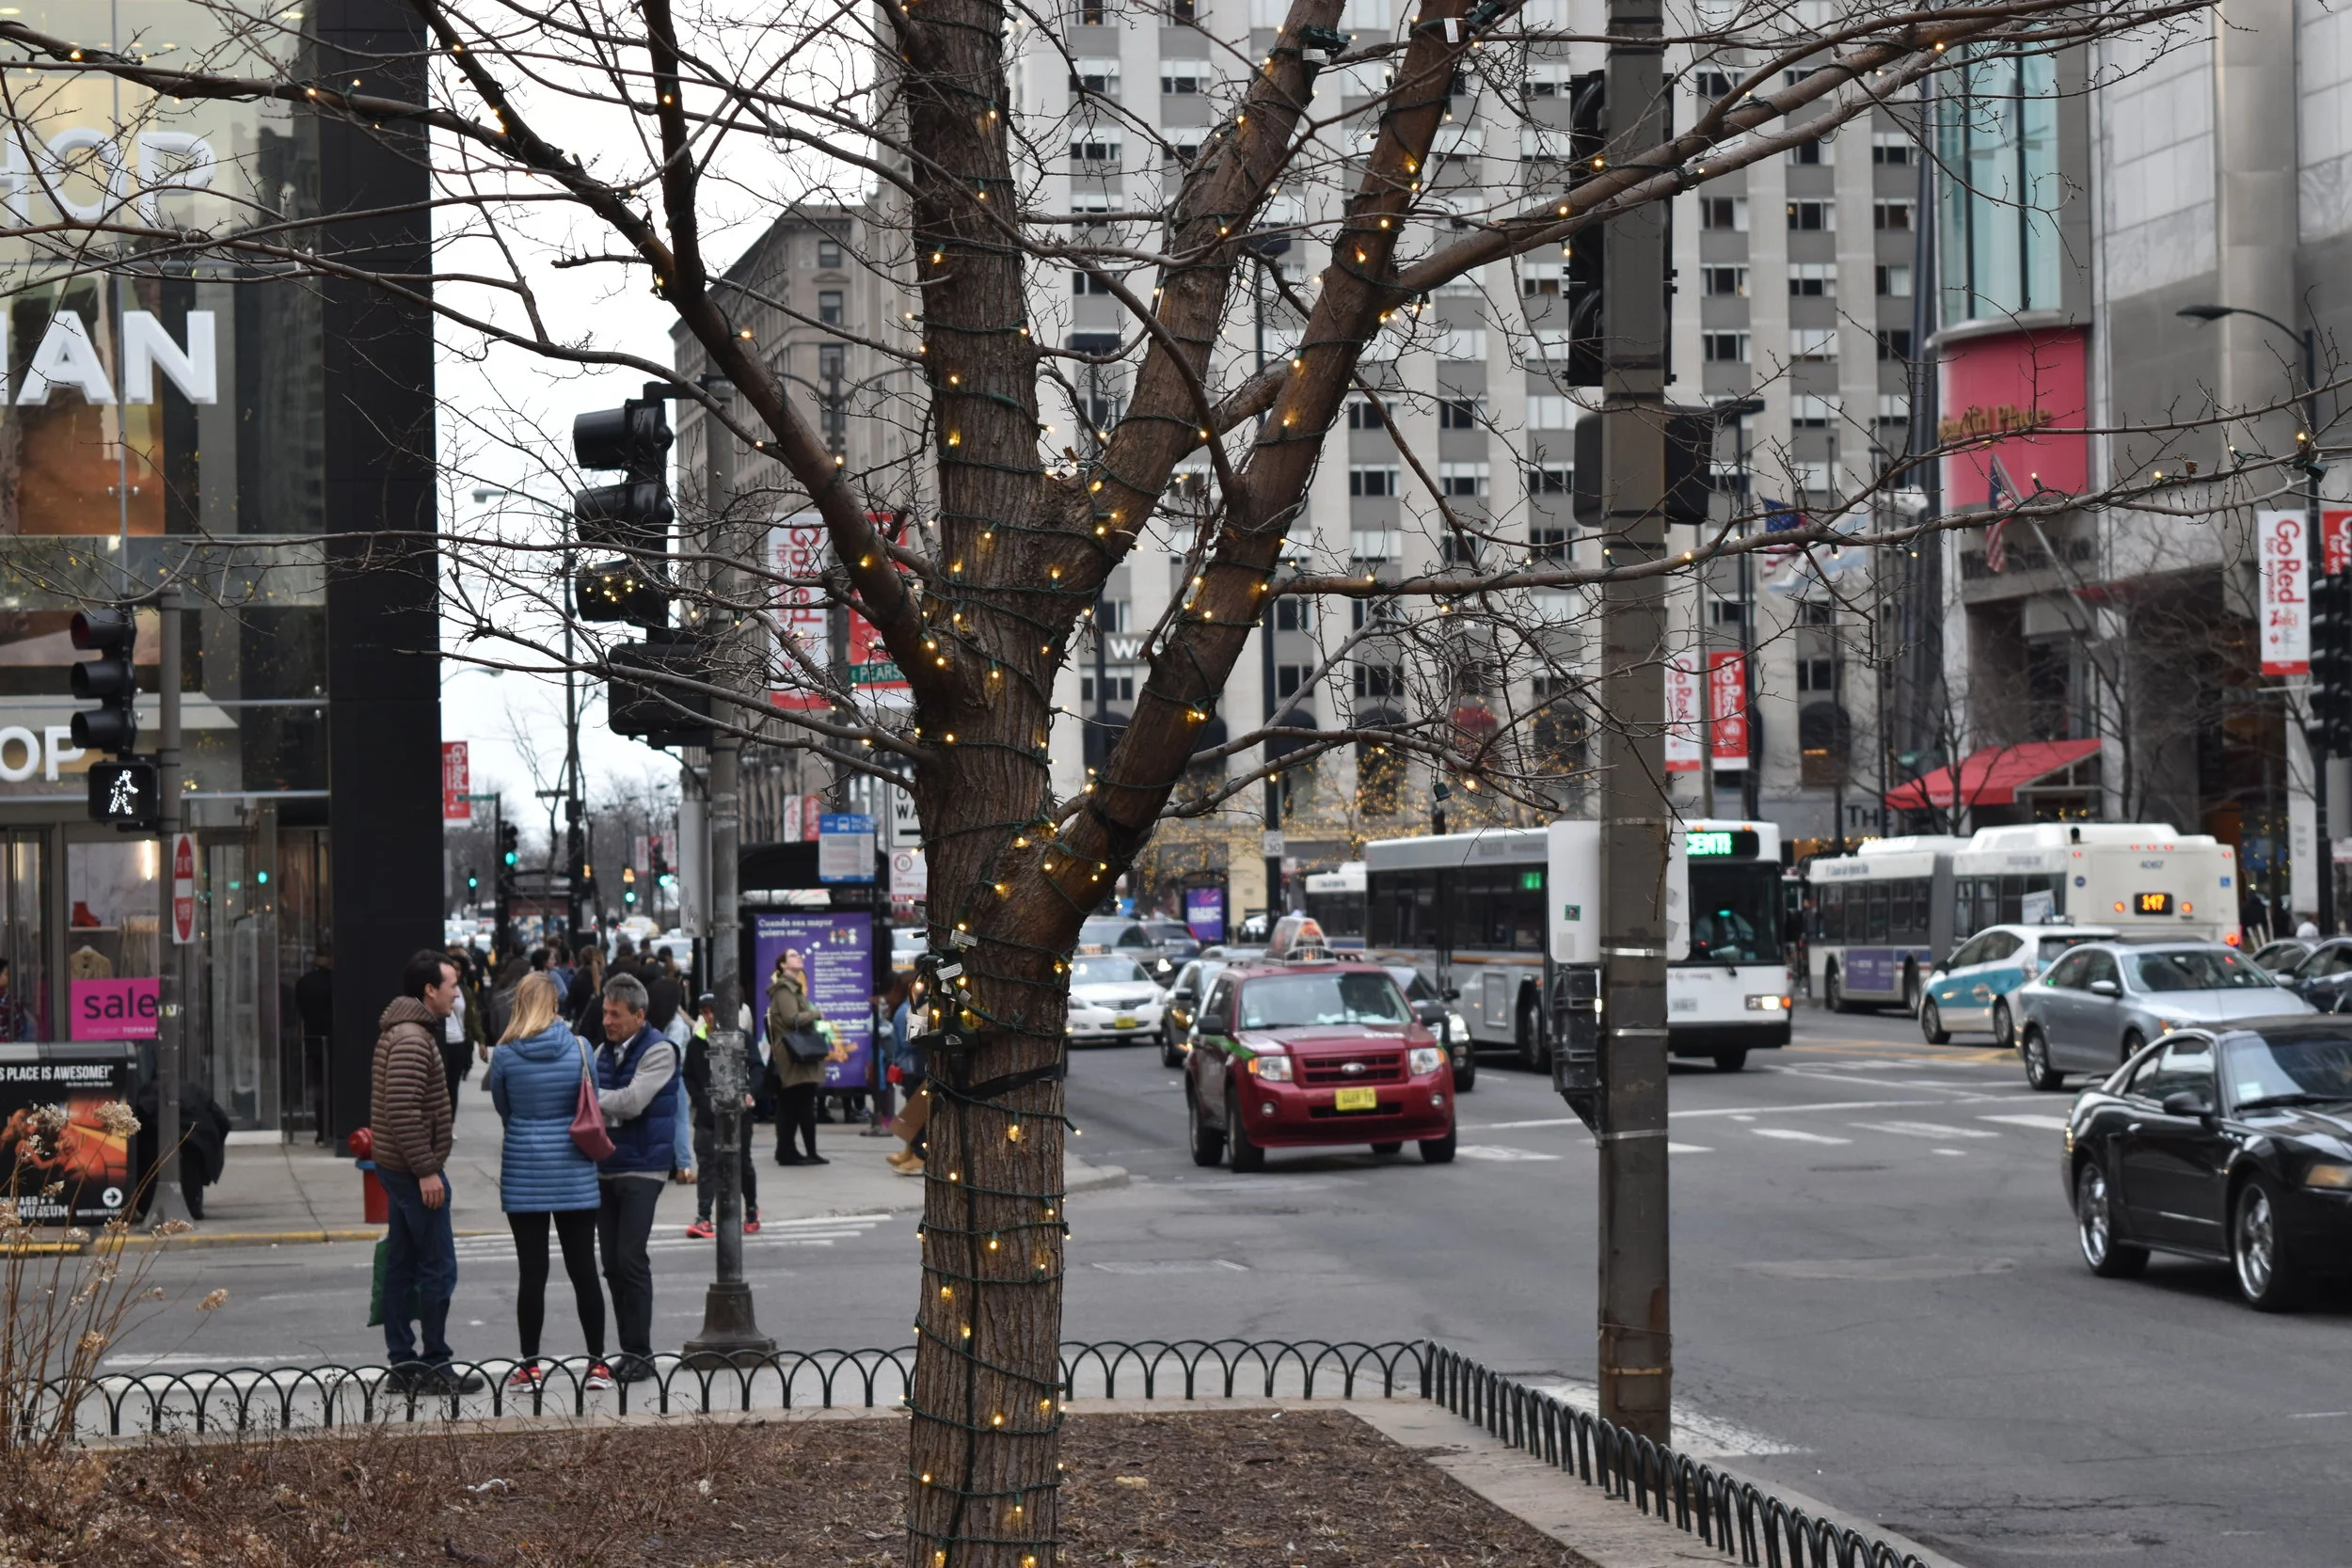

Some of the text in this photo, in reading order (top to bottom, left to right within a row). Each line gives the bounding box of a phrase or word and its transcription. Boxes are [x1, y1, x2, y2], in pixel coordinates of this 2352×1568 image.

[2275, 519, 2305, 604] Go Red
[2141, 894, 2165, 911] 147
[84, 985, 158, 1020] sale
[7, 1066, 40, 1083] PLACE
[41, 1066, 53, 1081] IS
[18, 1204, 69, 1219] MUSEUM
